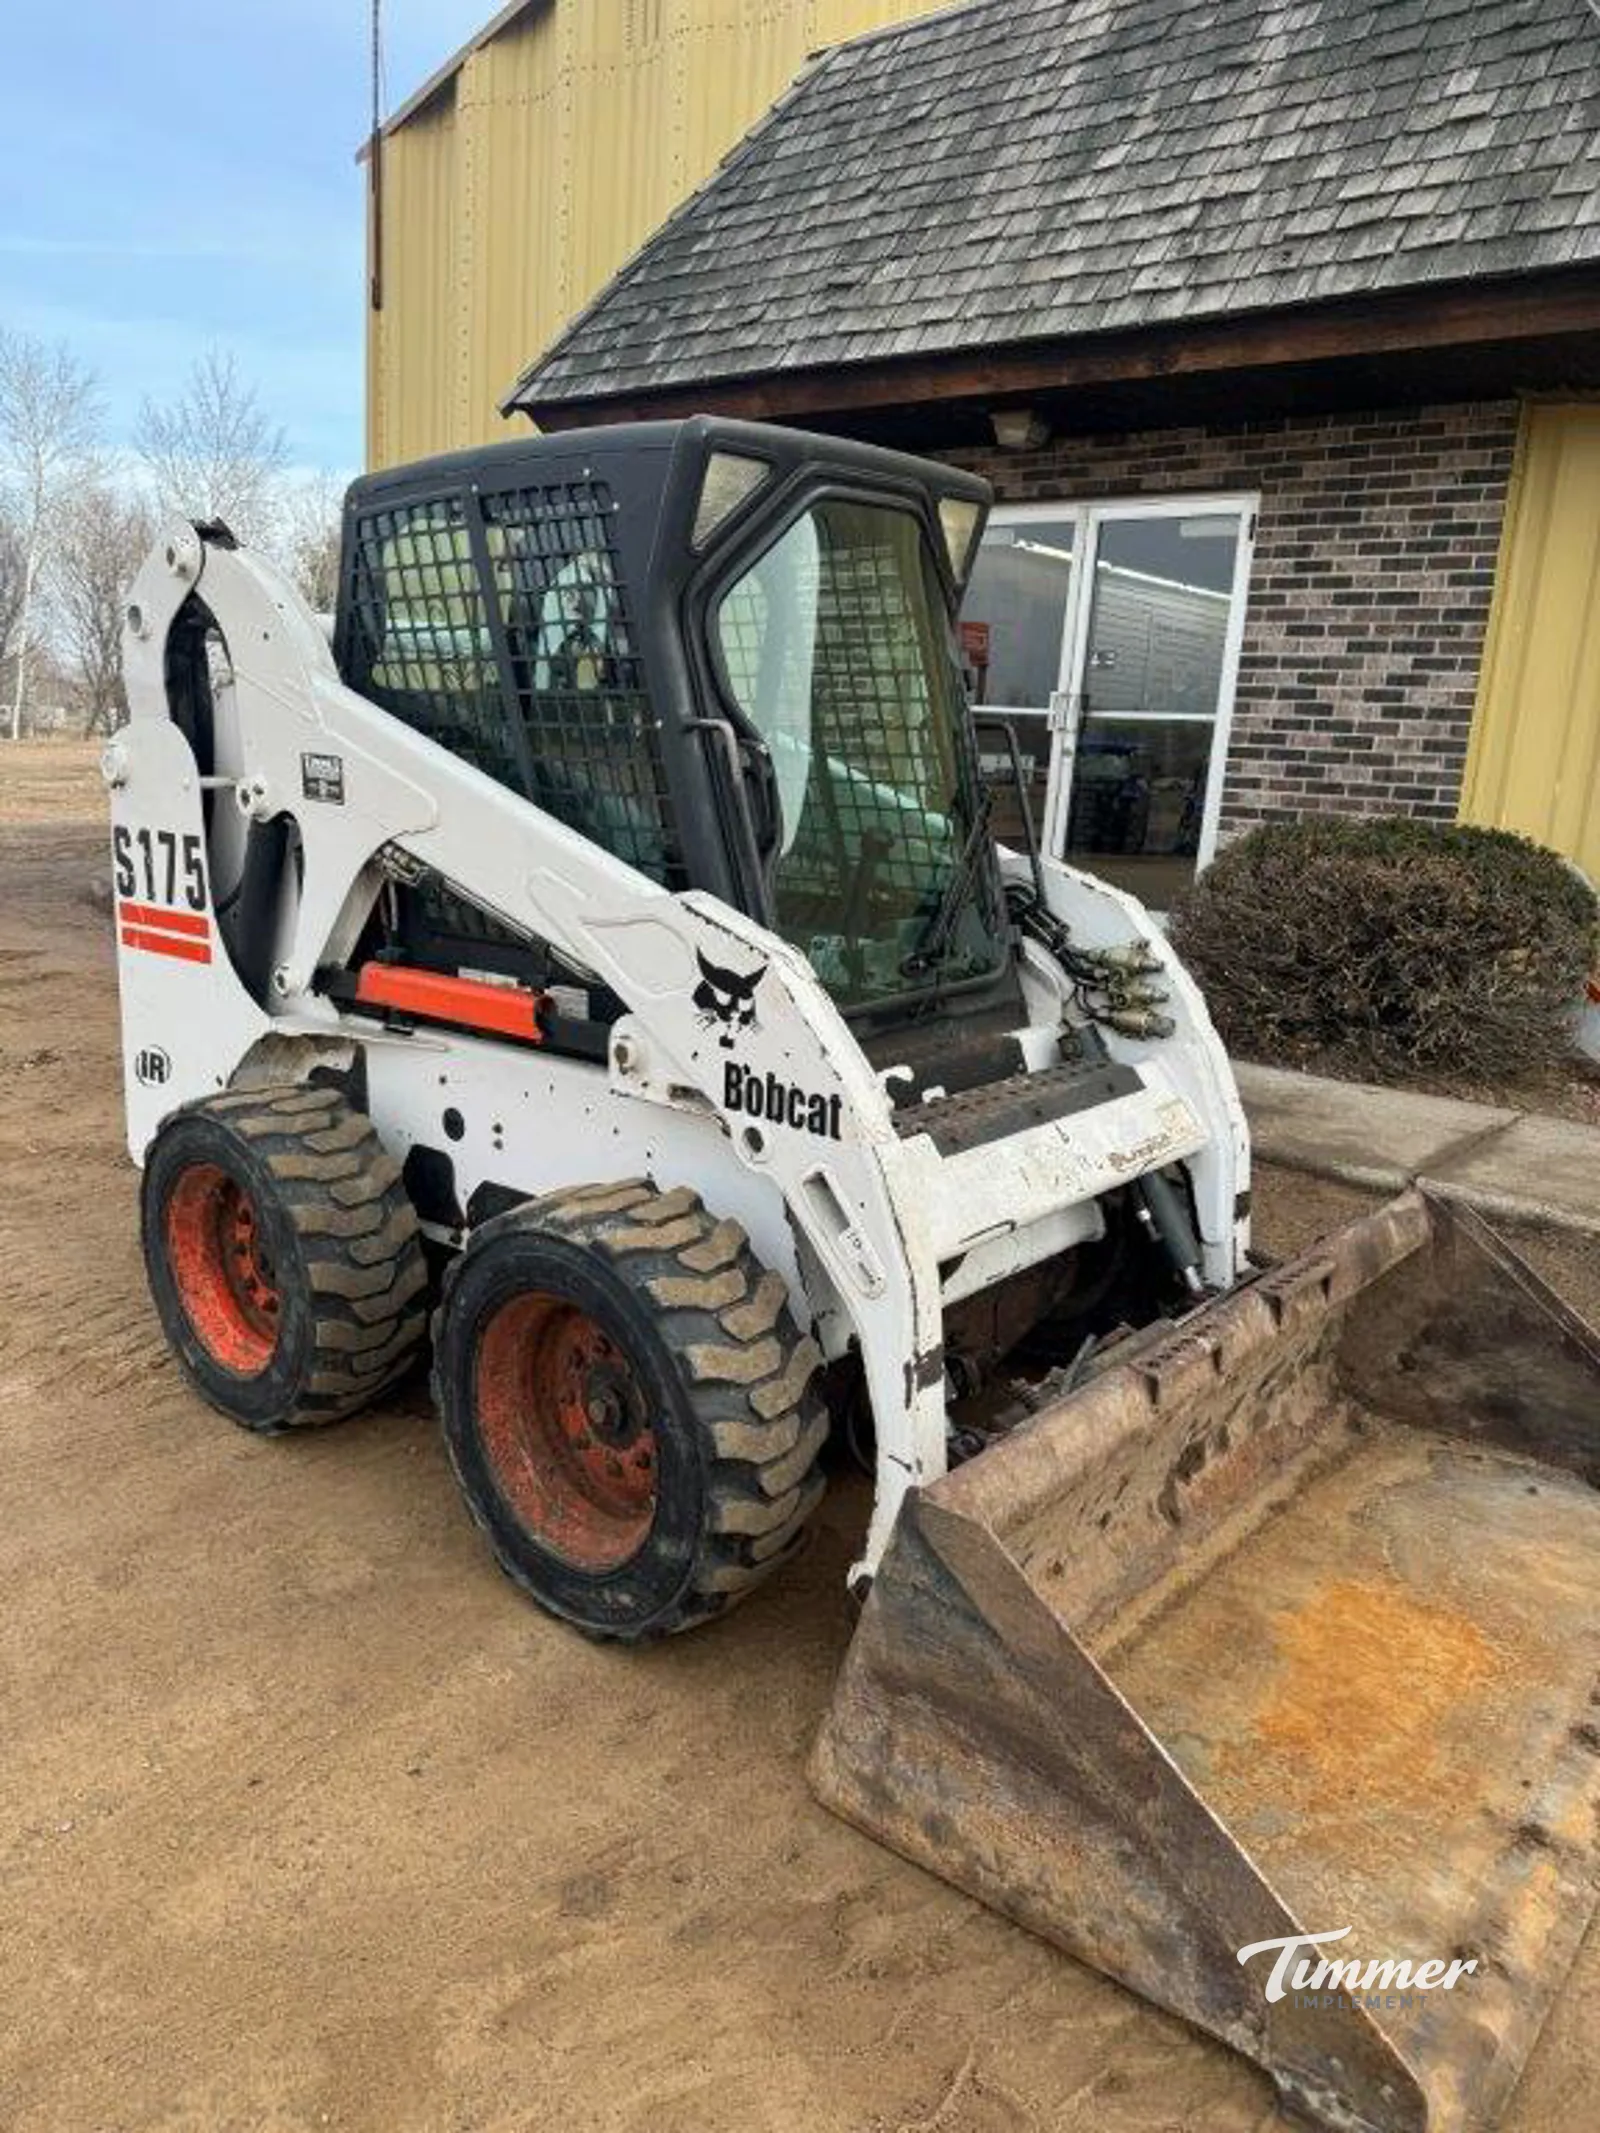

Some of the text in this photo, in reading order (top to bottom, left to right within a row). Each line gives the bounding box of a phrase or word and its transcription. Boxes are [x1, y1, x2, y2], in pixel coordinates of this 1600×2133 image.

[114, 825, 206, 911] S175
[141, 1049, 165, 1084] IR
[725, 1060, 842, 1141] Bobcat
